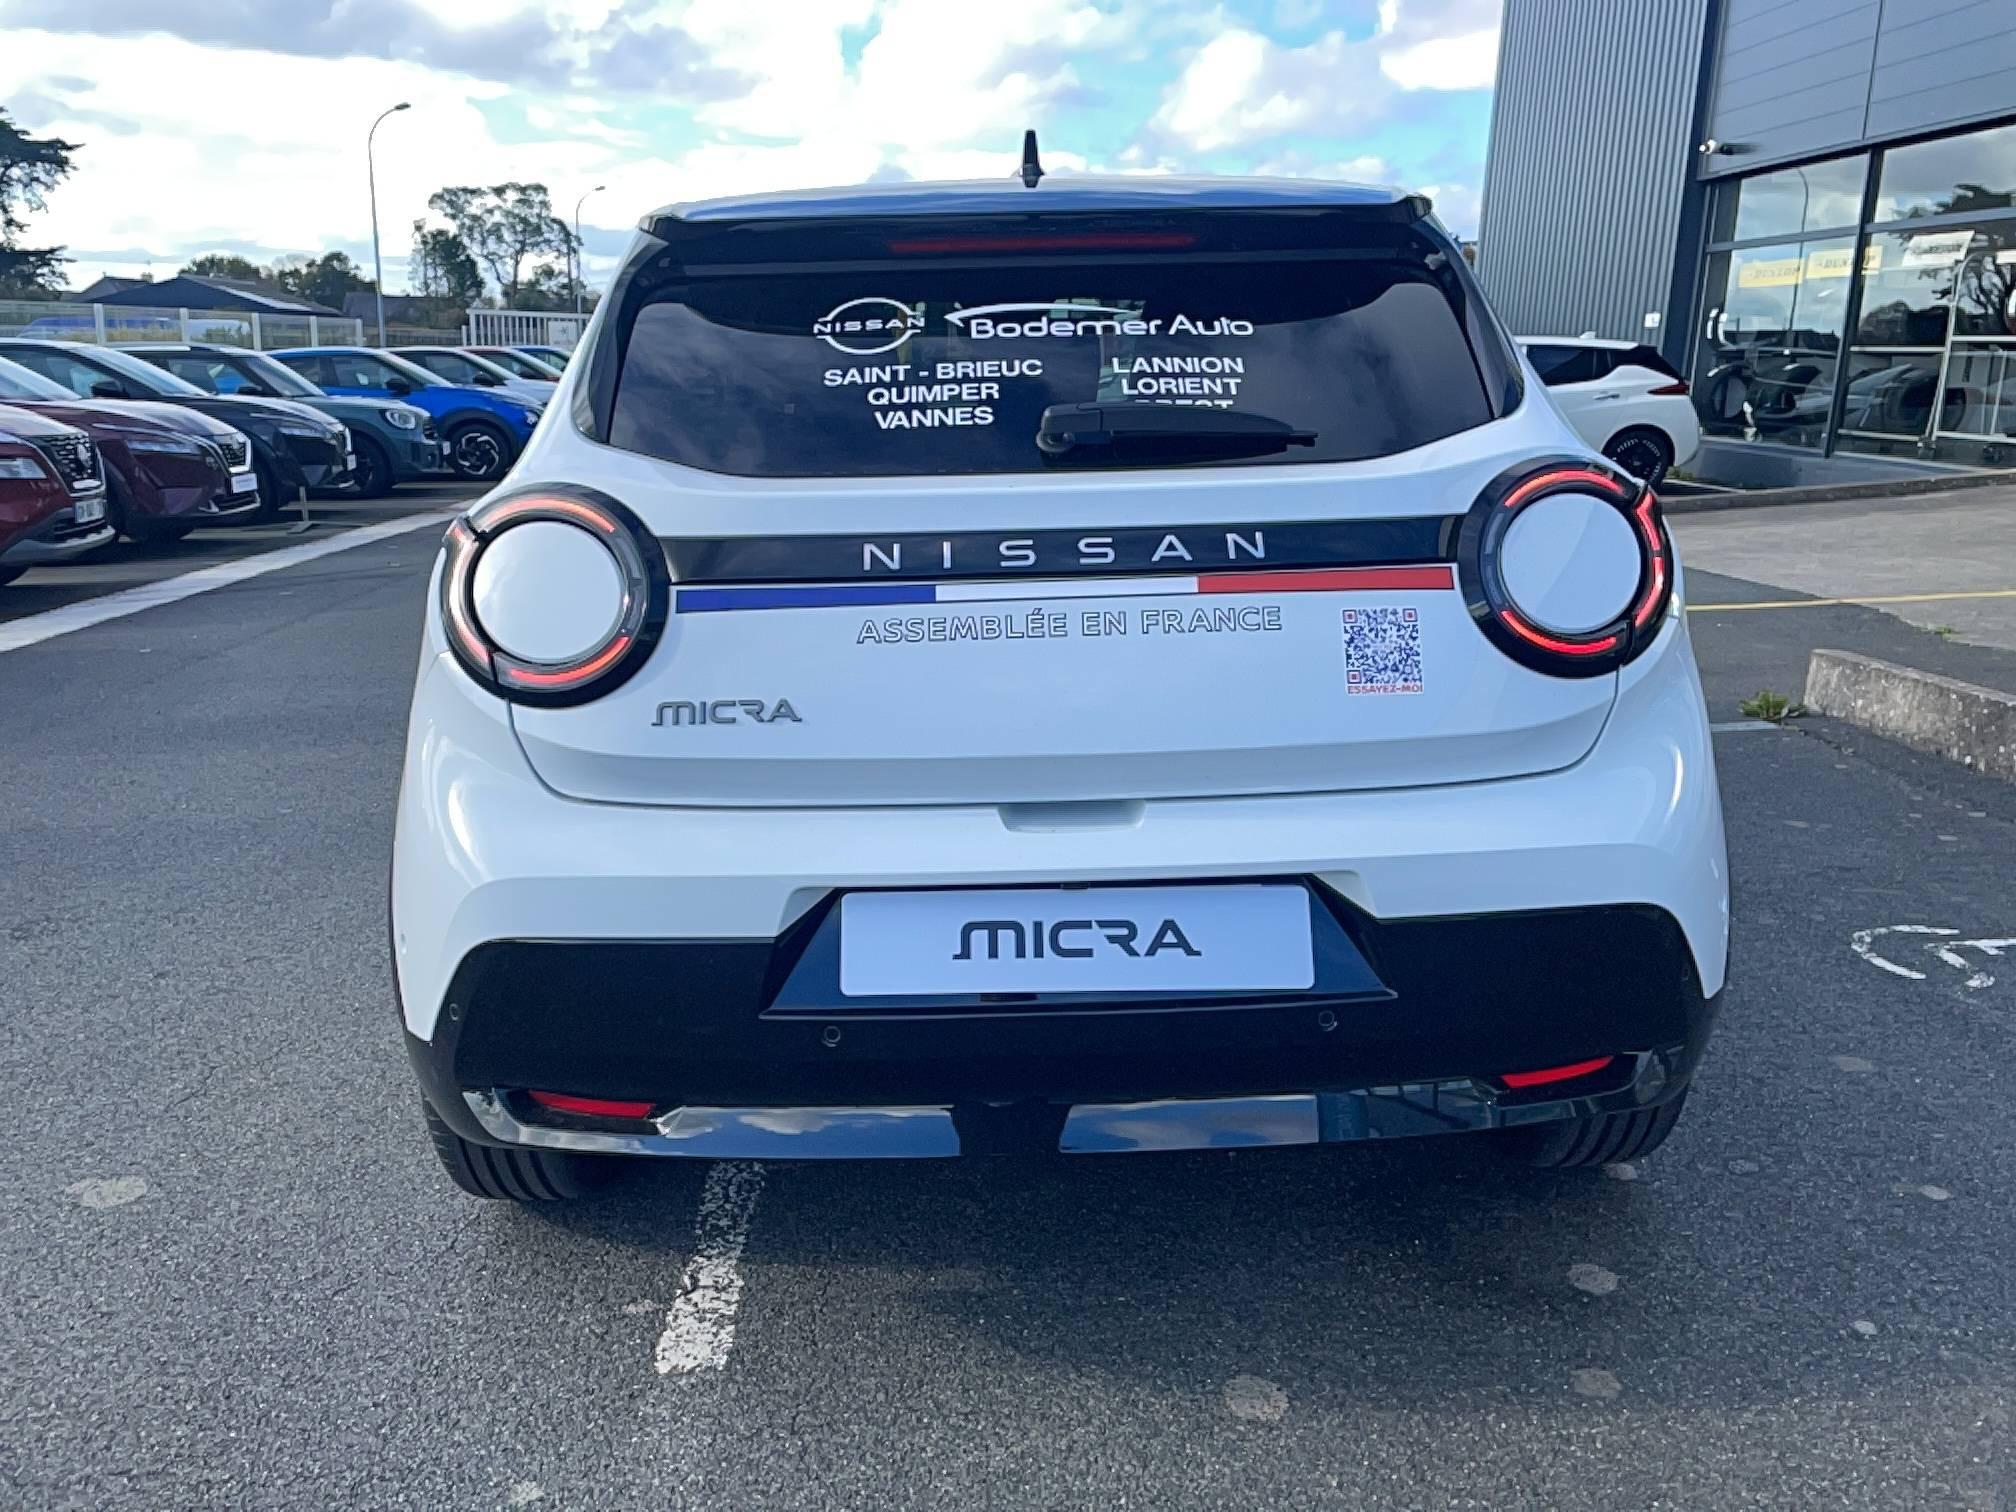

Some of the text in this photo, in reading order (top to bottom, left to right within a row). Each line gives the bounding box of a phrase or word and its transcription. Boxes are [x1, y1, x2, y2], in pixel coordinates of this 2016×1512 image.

[813, 316, 925, 334] NISSAN
[970, 313, 1255, 340] Bodemer Auto
[823, 364, 912, 387] SAINT
[935, 358, 1044, 381] BRIEUC
[1111, 356, 1246, 374] LANNION
[866, 382, 1000, 406] QUIMPER
[1121, 377, 1242, 395] LORIENT
[873, 405, 995, 430] VANNES
[862, 530, 1266, 572] NISSAN
[855, 605, 1283, 645] ASSEMBLÉE EN FRANCE
[1346, 683, 1424, 695] ESSAYEZ-MOI
[650, 697, 804, 727] MICRA
[951, 918, 1203, 961] MICRA
